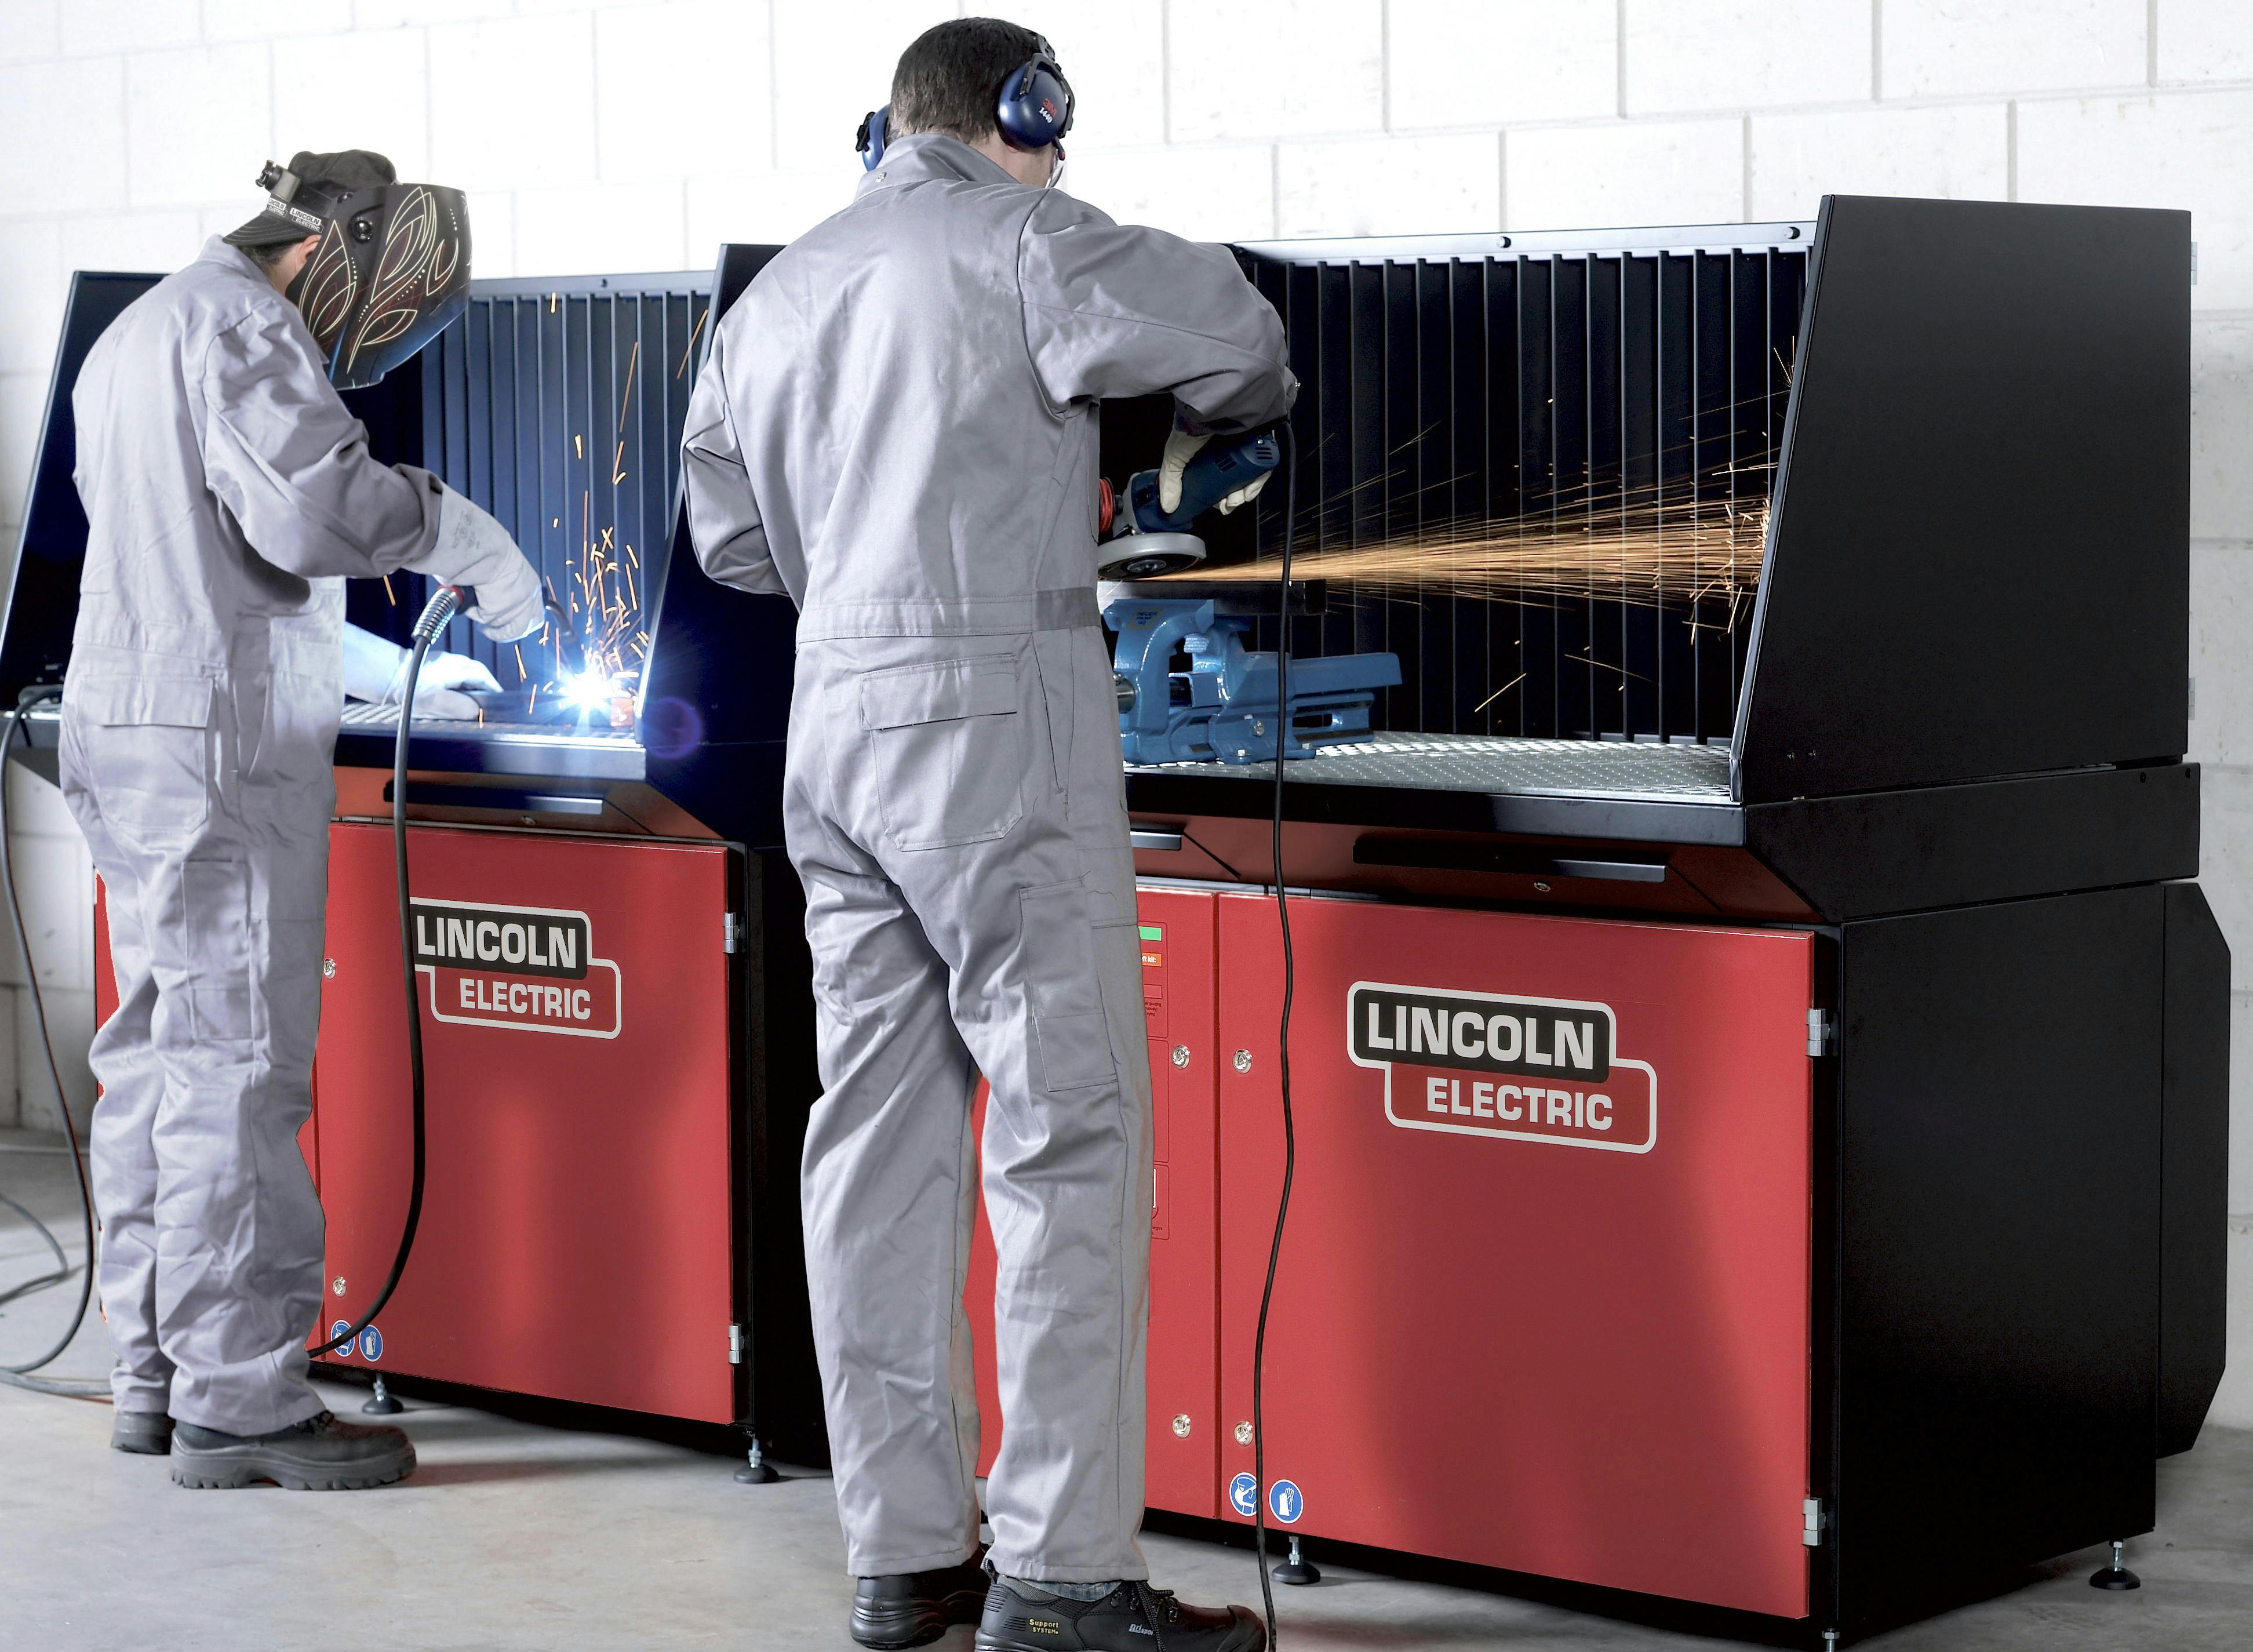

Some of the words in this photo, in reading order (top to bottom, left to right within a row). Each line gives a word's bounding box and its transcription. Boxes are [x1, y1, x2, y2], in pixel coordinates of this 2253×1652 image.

[1039, 107, 1053, 123] 1440
[269, 205, 285, 216] ELECTRIC
[292, 209, 319, 225] LINCOLN
[296, 218, 321, 231] ELECTRIC
[417, 915, 576, 969] LINCOLN
[460, 978, 591, 1020] ELECTRIC
[1368, 1002, 1593, 1070] LINCOLN
[1426, 1076, 1613, 1130] ELECTRIC
[1029, 1619, 1059, 1628] Support
